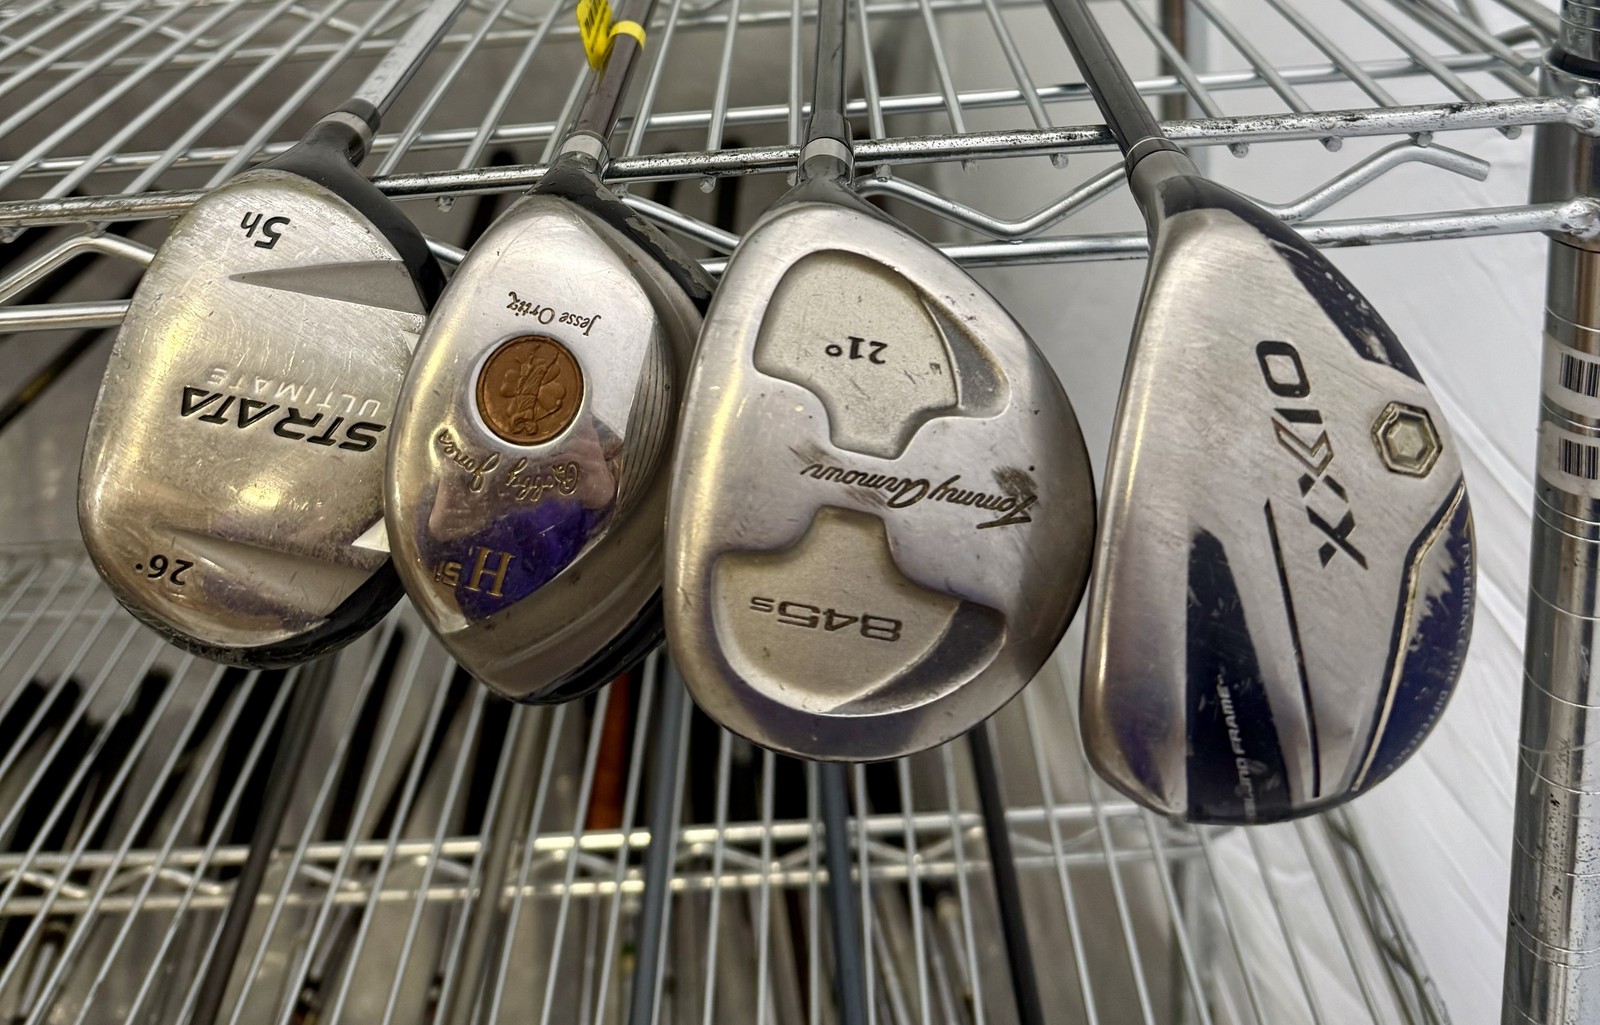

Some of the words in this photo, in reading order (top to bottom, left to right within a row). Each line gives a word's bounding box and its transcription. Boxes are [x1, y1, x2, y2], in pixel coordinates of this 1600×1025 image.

[240, 211, 291, 249] 5h
[507, 291, 556, 325] Ortiz
[558, 310, 602, 336] Jesse
[825, 335, 888, 364] 21°
[207, 367, 381, 417] ULTIMATE
[181, 385, 386, 452] STRATA
[438, 428, 500, 493] Jones
[1255, 340, 1369, 571] XXIO
[507, 456, 581, 502] Bobby
[800, 463, 930, 508] Armour
[927, 474, 1038, 529] Tommy
[135, 554, 194, 586] 26°
